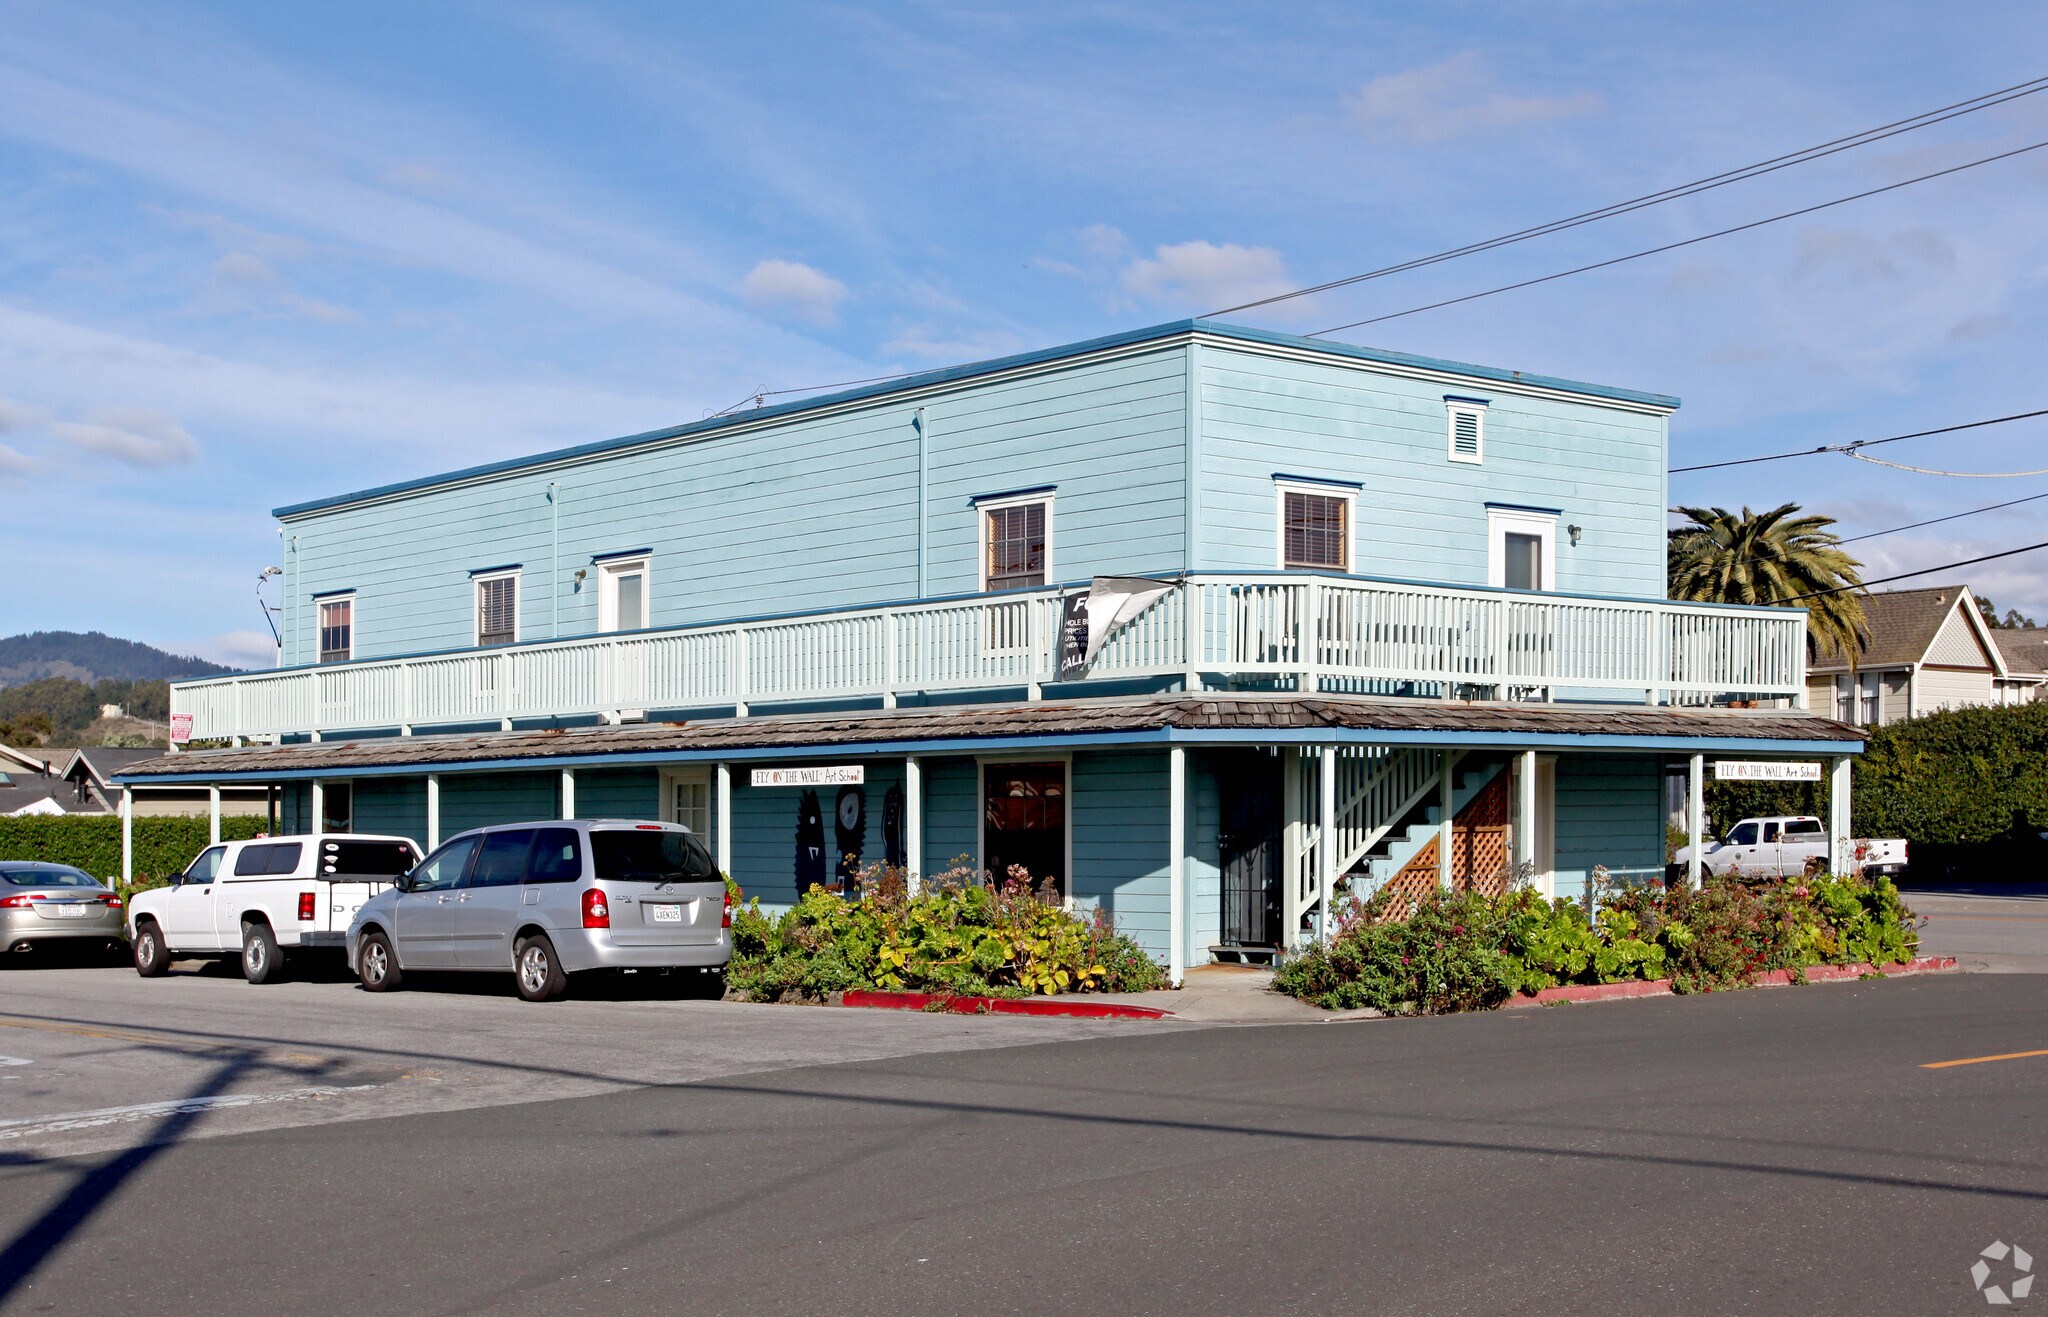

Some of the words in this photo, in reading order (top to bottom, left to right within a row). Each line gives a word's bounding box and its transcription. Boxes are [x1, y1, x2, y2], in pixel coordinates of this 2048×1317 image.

[1061, 653, 1083, 671] CALL
[785, 770, 798, 783] THE
[824, 768, 837, 783] Art
[1750, 765, 1762, 777] THE
[1786, 765, 1798, 778] Art
